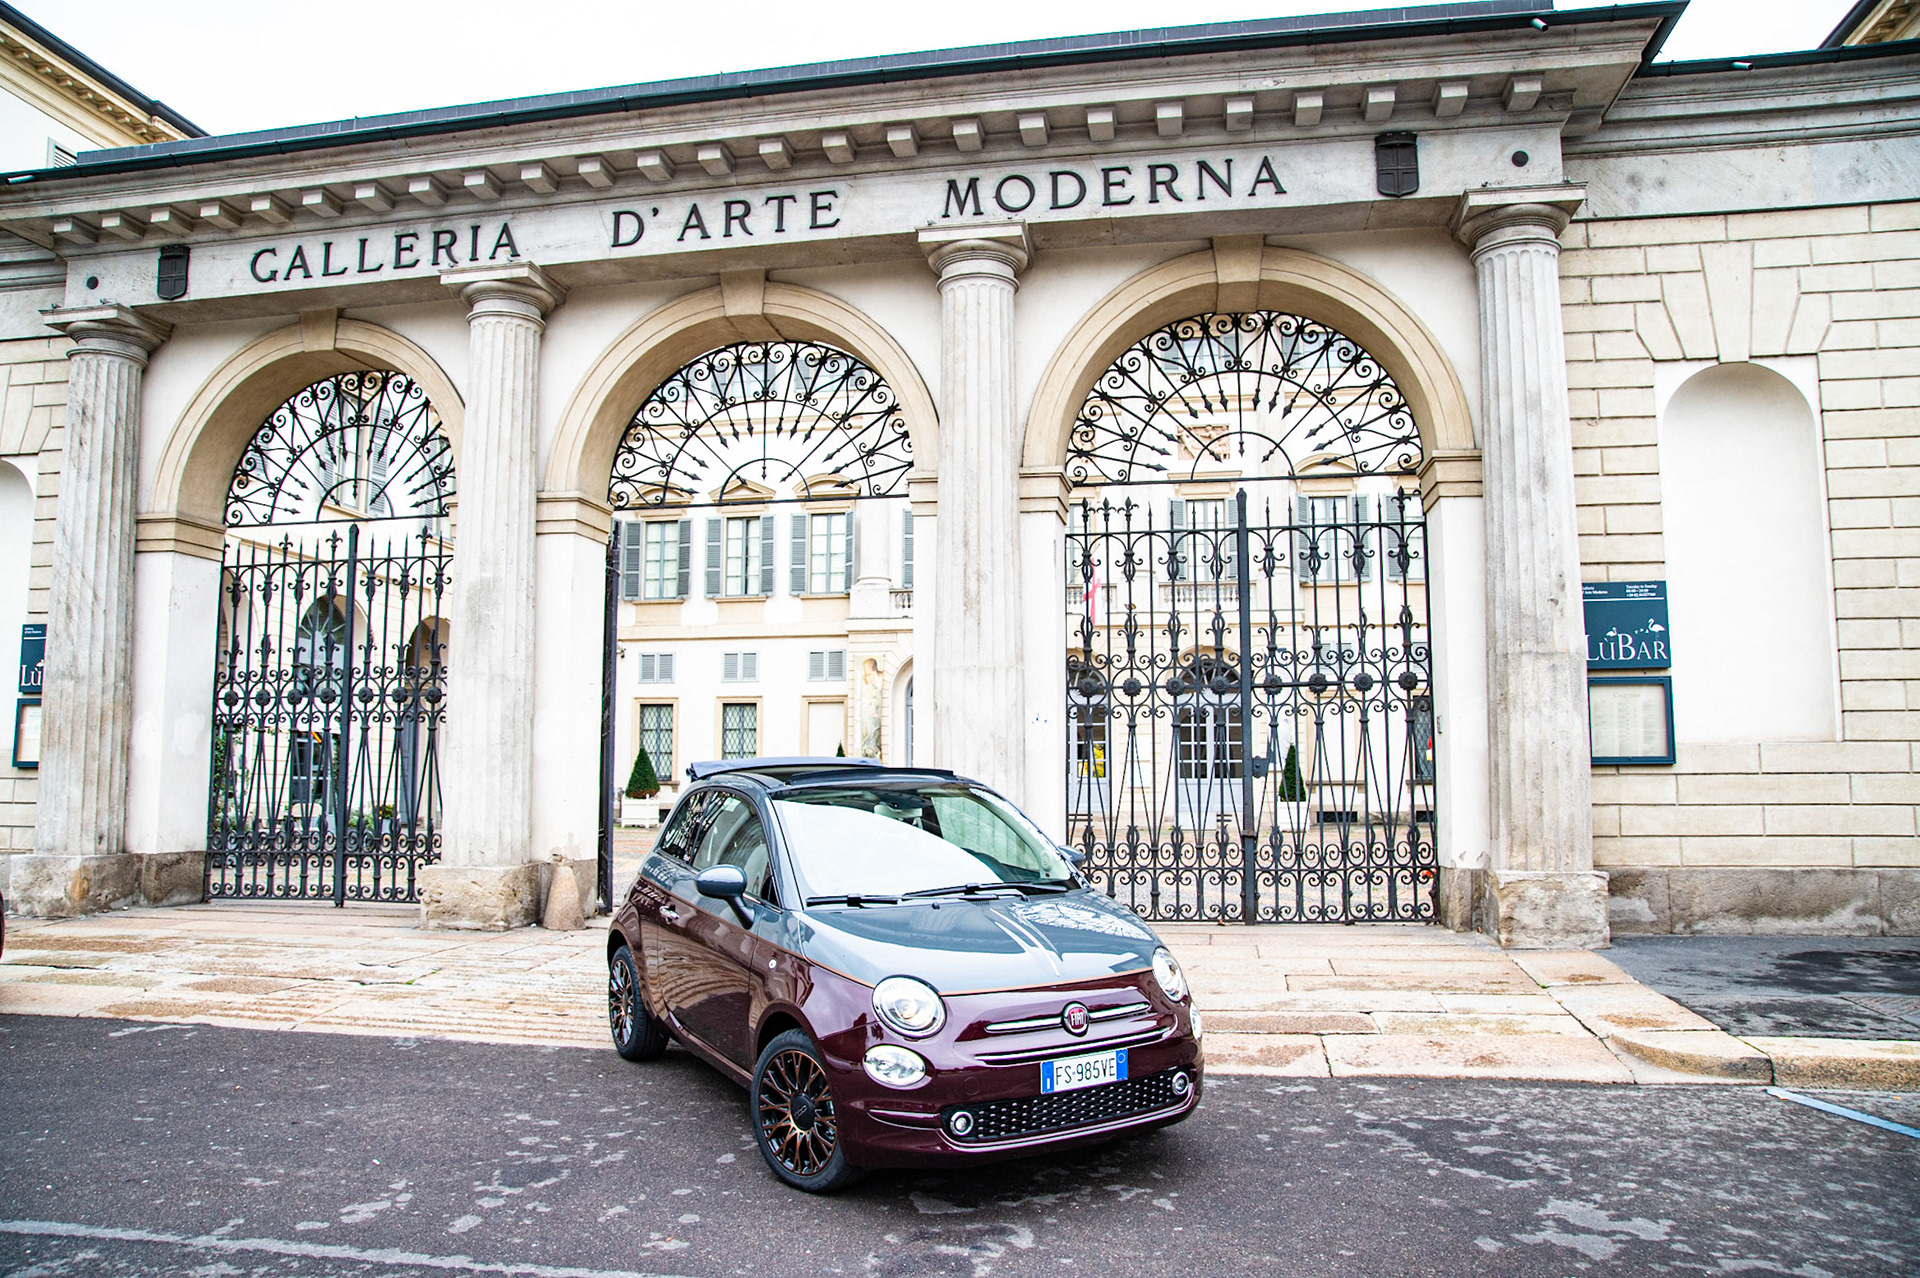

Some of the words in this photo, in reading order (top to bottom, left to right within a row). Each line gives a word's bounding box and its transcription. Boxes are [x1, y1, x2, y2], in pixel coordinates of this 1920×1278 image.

[250, 221, 522, 283] GALLERIA
[611, 189, 842, 248] D'ARTE
[941, 155, 1288, 219] MODERNA
[1070, 1012, 1084, 1026] FIAT
